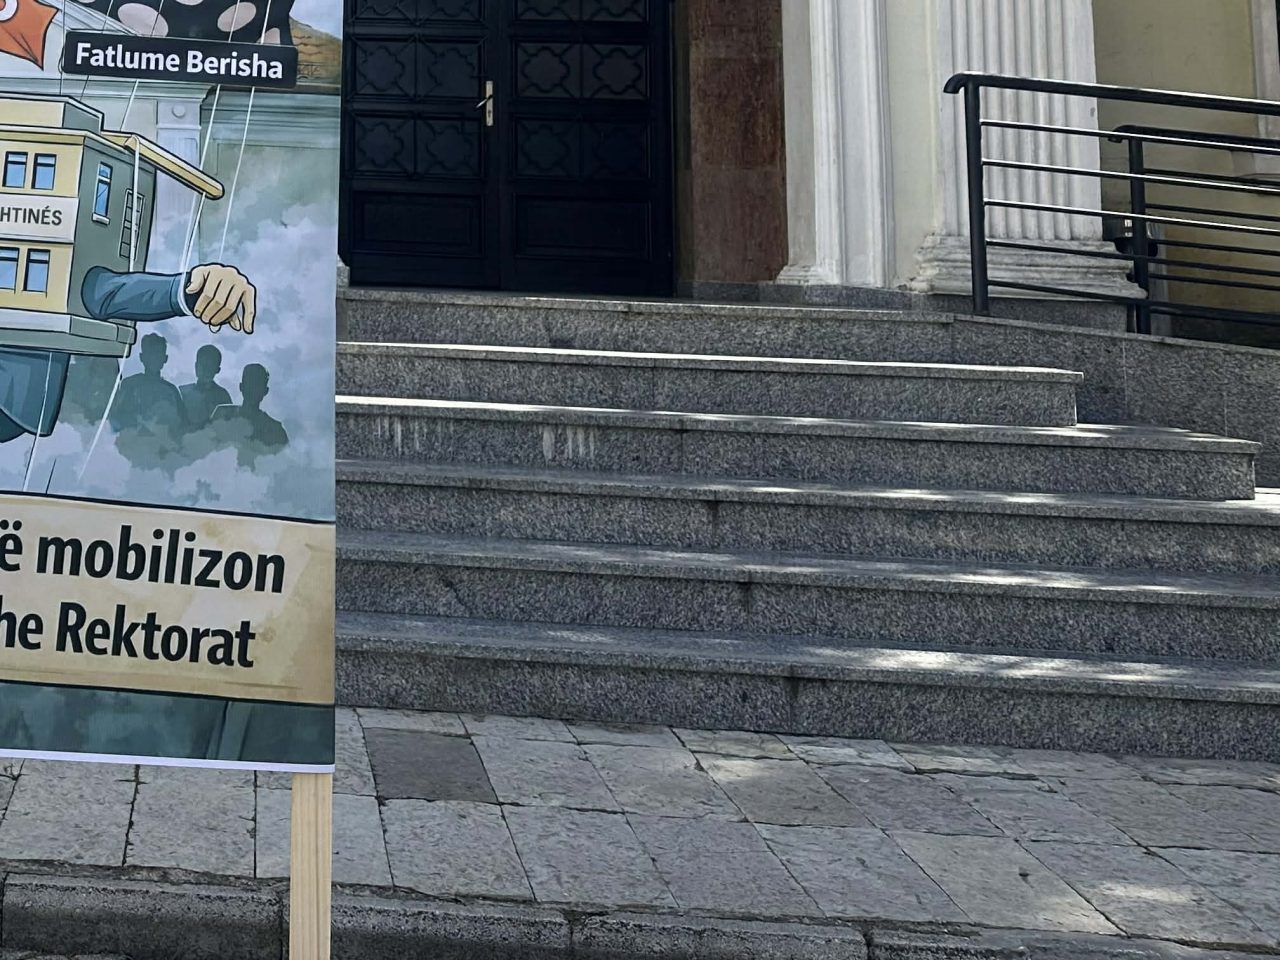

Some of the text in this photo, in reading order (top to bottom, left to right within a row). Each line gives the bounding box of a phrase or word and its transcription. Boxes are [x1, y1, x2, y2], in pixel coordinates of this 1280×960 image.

[76, 42, 283, 79] Fatlume Berisha
[37, 525, 286, 593] mobilizon
[55, 601, 256, 667] Rektorat
